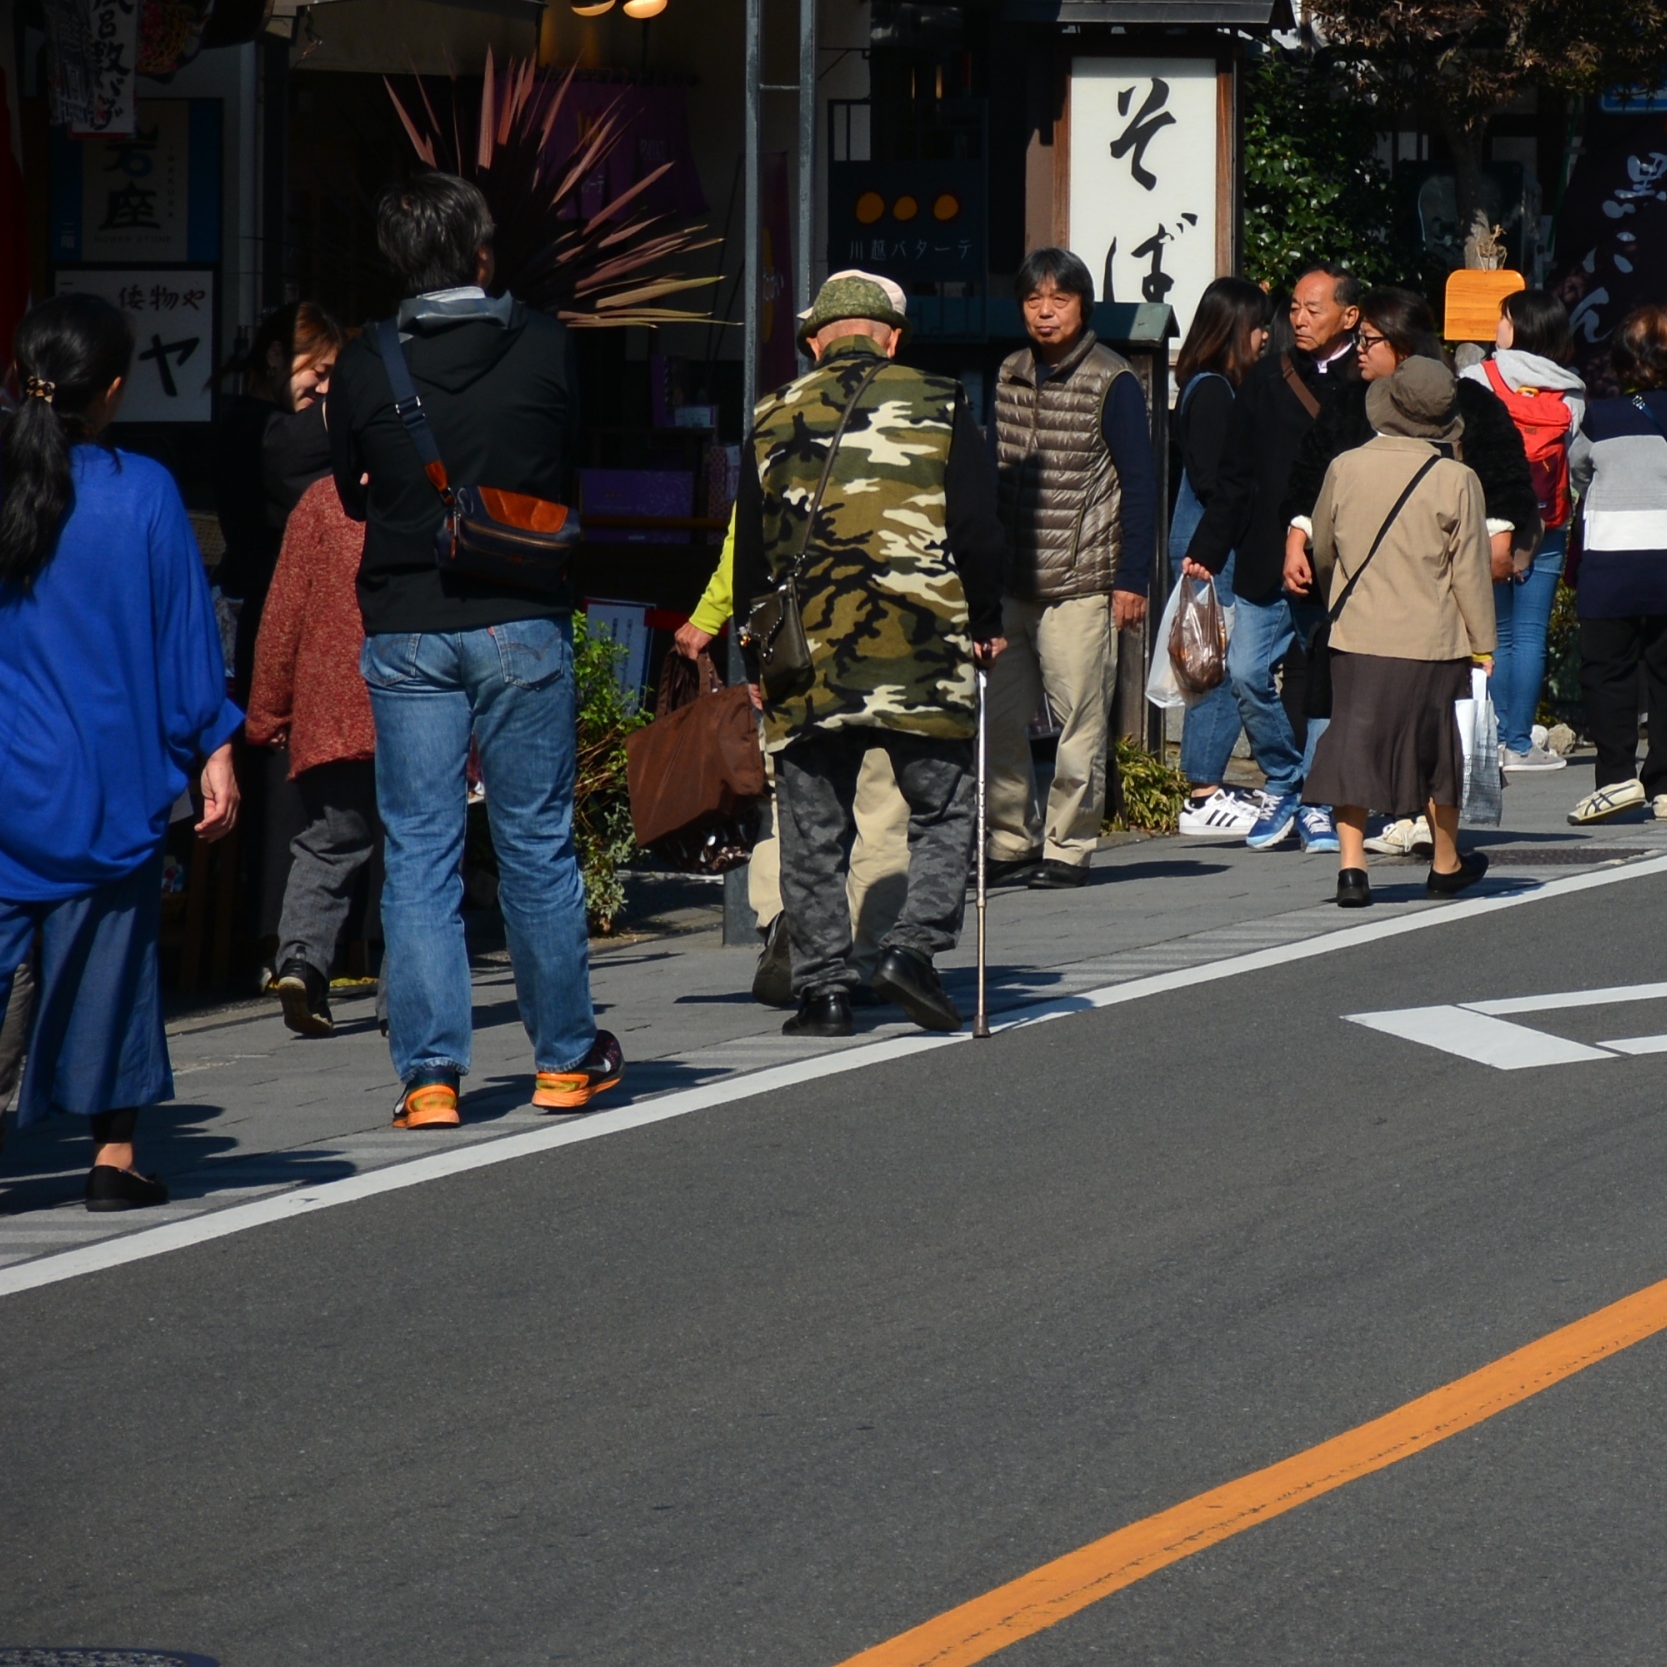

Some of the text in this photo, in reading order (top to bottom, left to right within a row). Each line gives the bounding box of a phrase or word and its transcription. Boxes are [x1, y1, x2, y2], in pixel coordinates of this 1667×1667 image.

[1102, 76, 1198, 302] そば
[850, 238, 972, 261] 川越バターテ
[119, 284, 206, 311] 倭物や
[138, 333, 200, 397] ヤ
